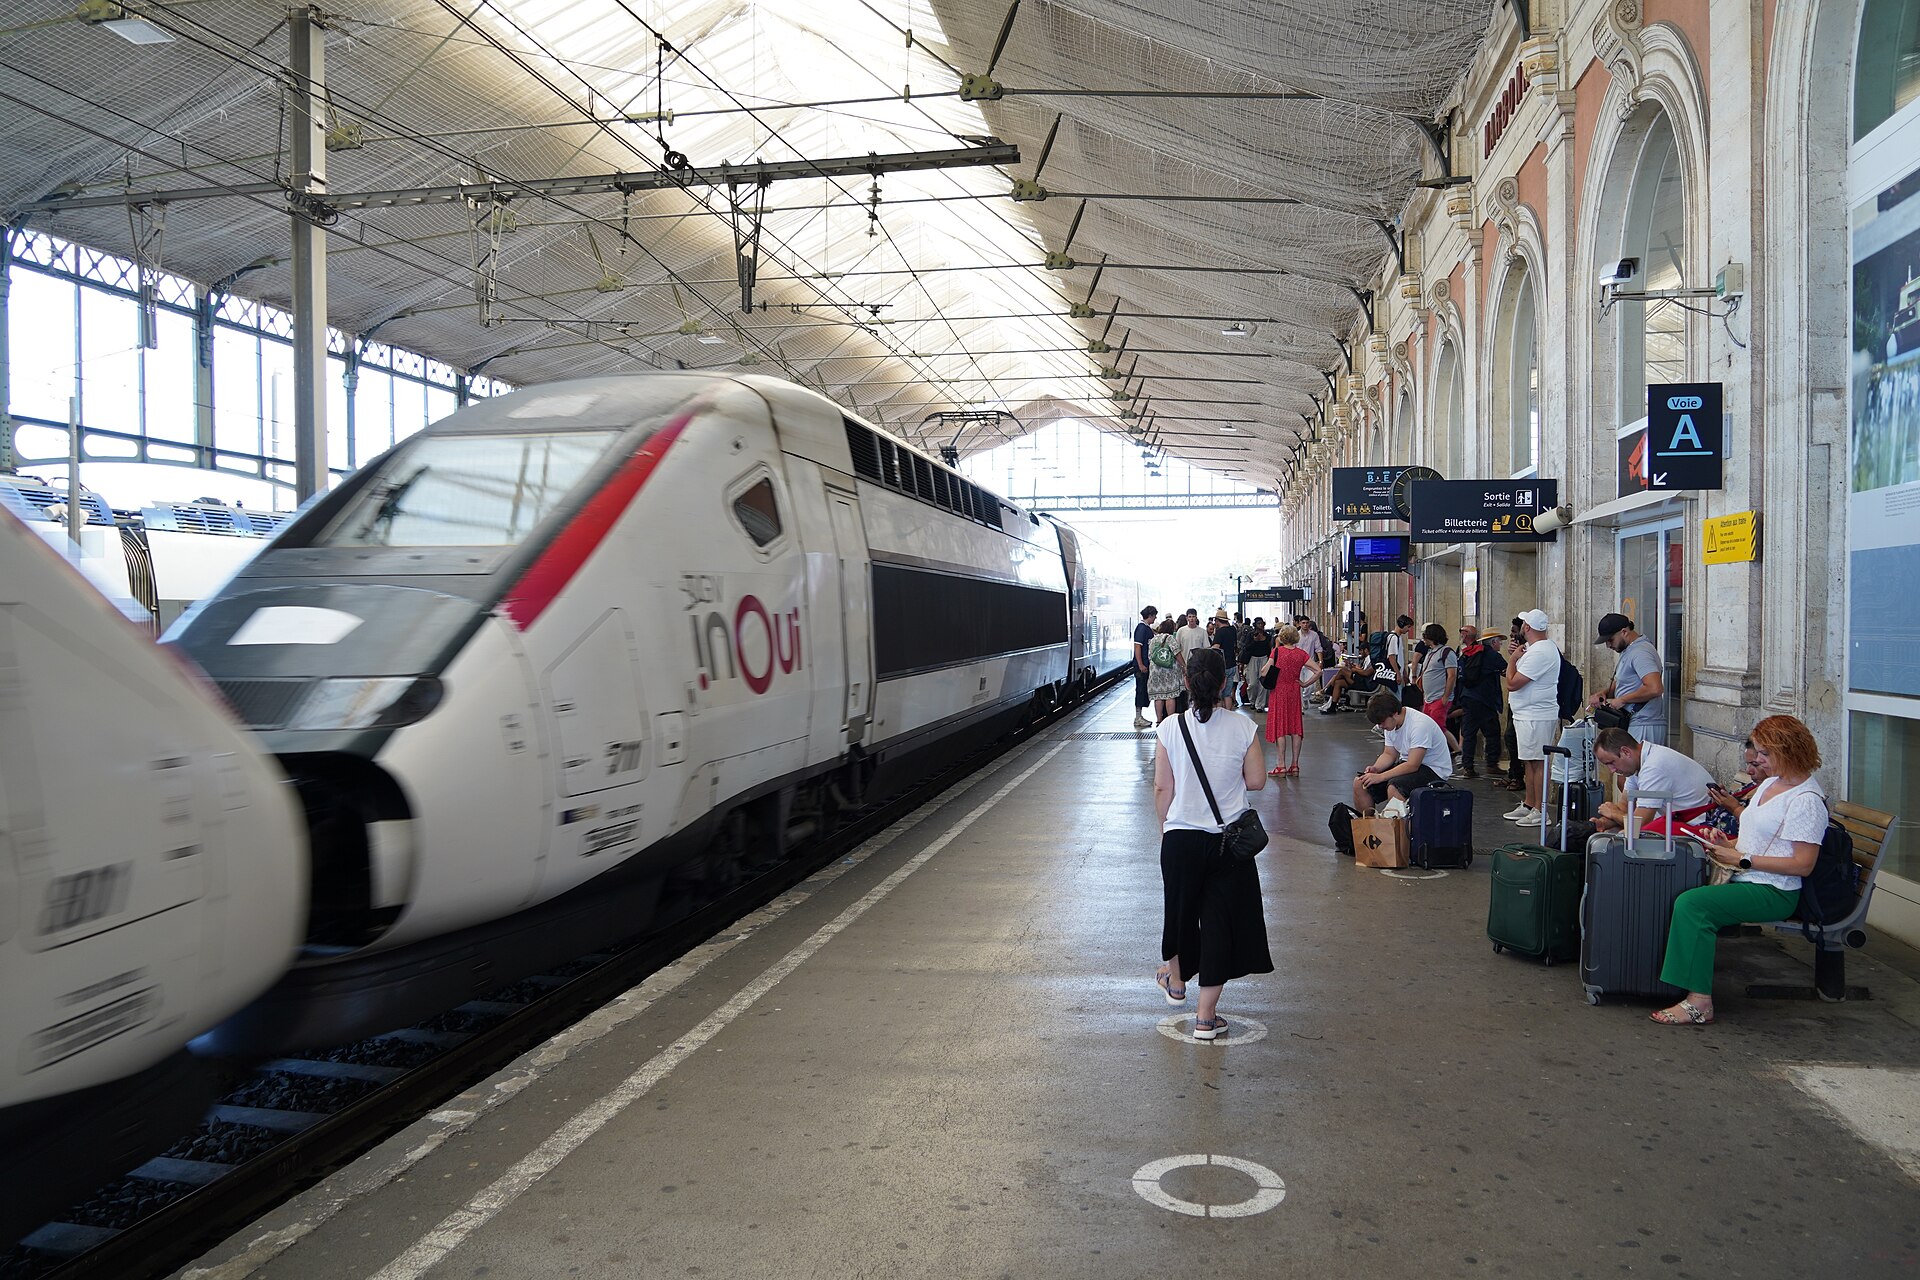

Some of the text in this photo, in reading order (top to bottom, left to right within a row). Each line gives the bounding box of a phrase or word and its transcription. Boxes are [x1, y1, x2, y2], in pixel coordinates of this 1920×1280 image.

[1484, 61, 1531, 160] NARBON
[1671, 398, 1698, 408] Voie
[1669, 414, 1703, 449] A
[1367, 474, 1390, 482] B E
[1484, 492, 1511, 501] Sortie
[1444, 518, 1488, 527] Billetterie
[1373, 662, 1397, 680] Patta
